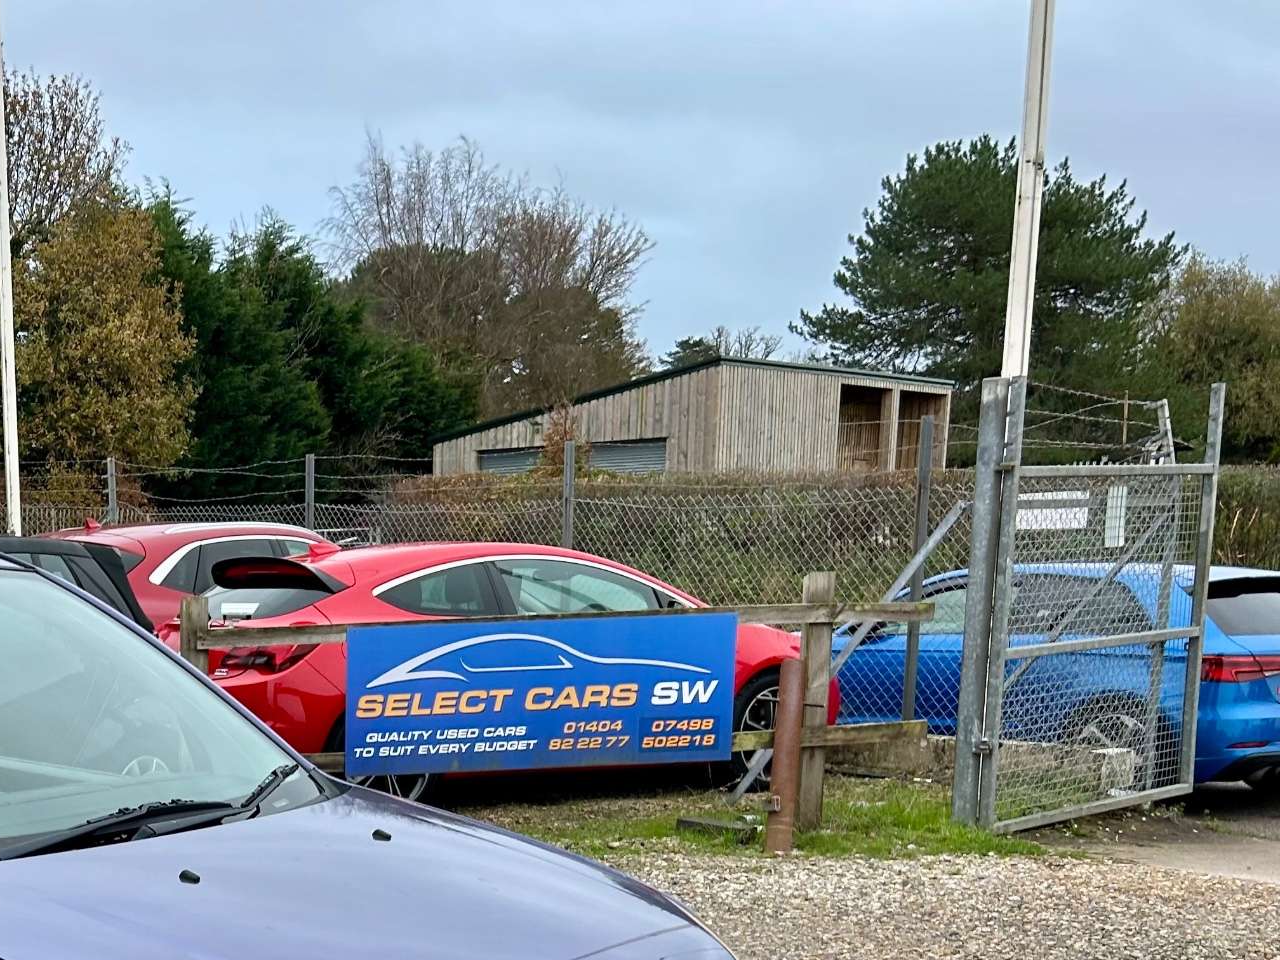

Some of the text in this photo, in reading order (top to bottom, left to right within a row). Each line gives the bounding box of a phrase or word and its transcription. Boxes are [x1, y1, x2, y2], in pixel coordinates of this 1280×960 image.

[356, 680, 719, 718] SELECT CARS SW
[563, 719, 624, 734] 01404
[651, 718, 715, 732] 07498
[365, 726, 527, 743] QUALITY USED CARS
[641, 734, 716, 748] 502218
[353, 739, 538, 758] TO SUIT EVERY BUDGET
